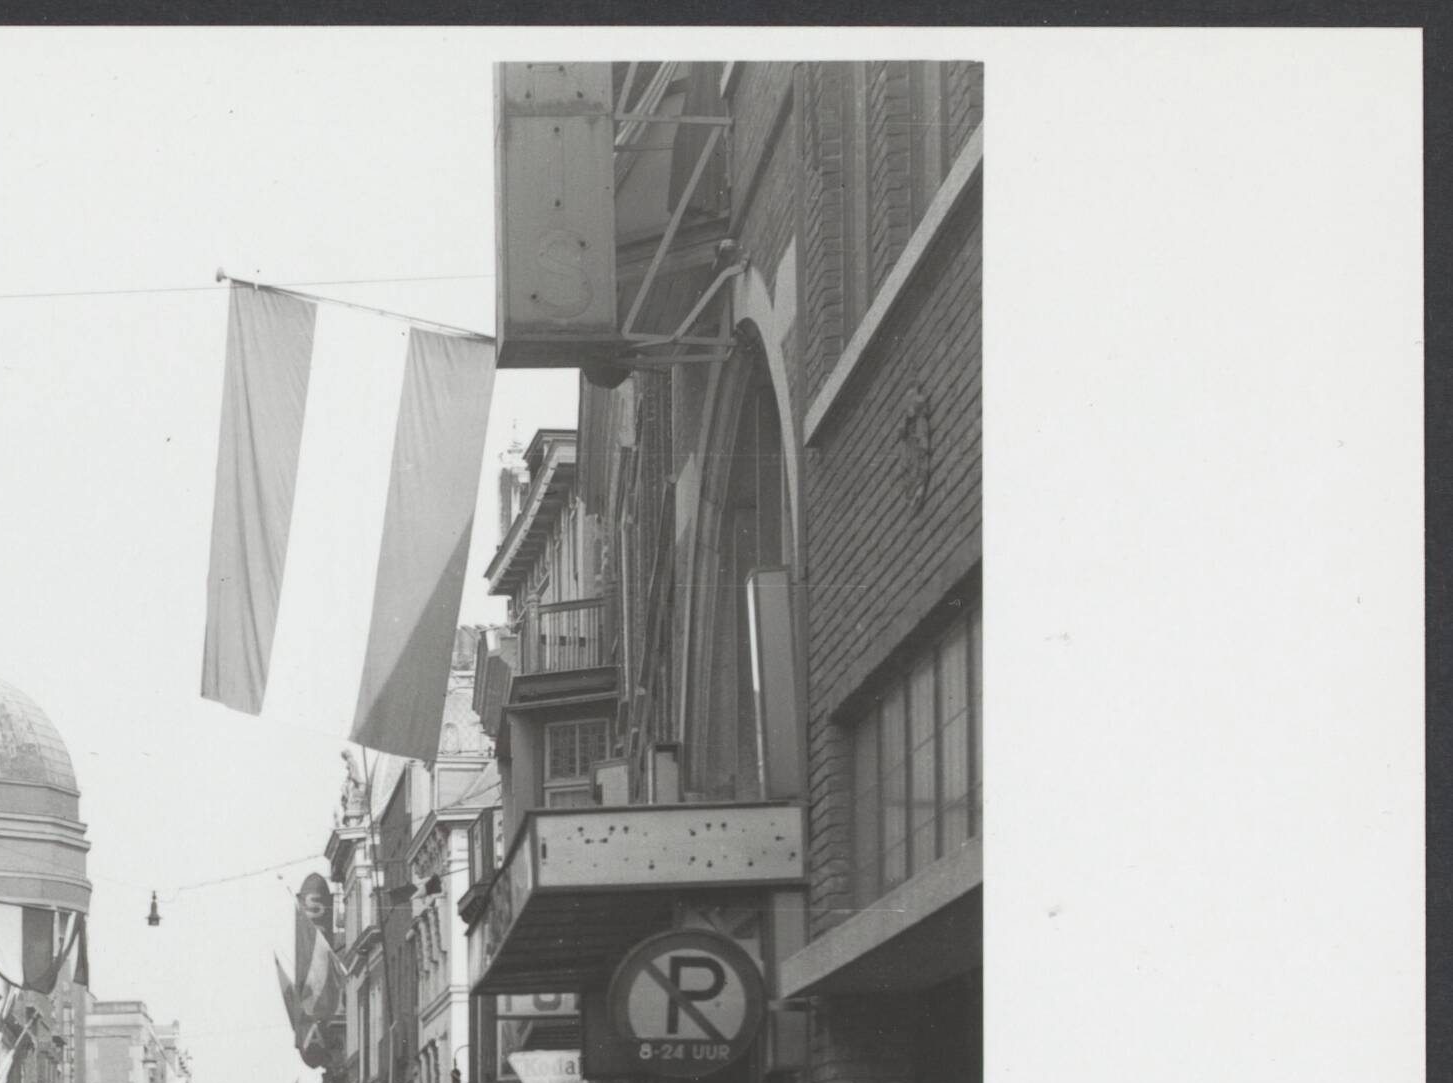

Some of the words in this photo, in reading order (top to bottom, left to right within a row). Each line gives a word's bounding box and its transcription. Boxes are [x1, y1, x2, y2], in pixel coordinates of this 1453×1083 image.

[667, 956, 726, 1035] P
[638, 1042, 685, 1060] 8-24
[691, 1044, 731, 1060] UUR
[524, 1056, 578, 1076] Koda
